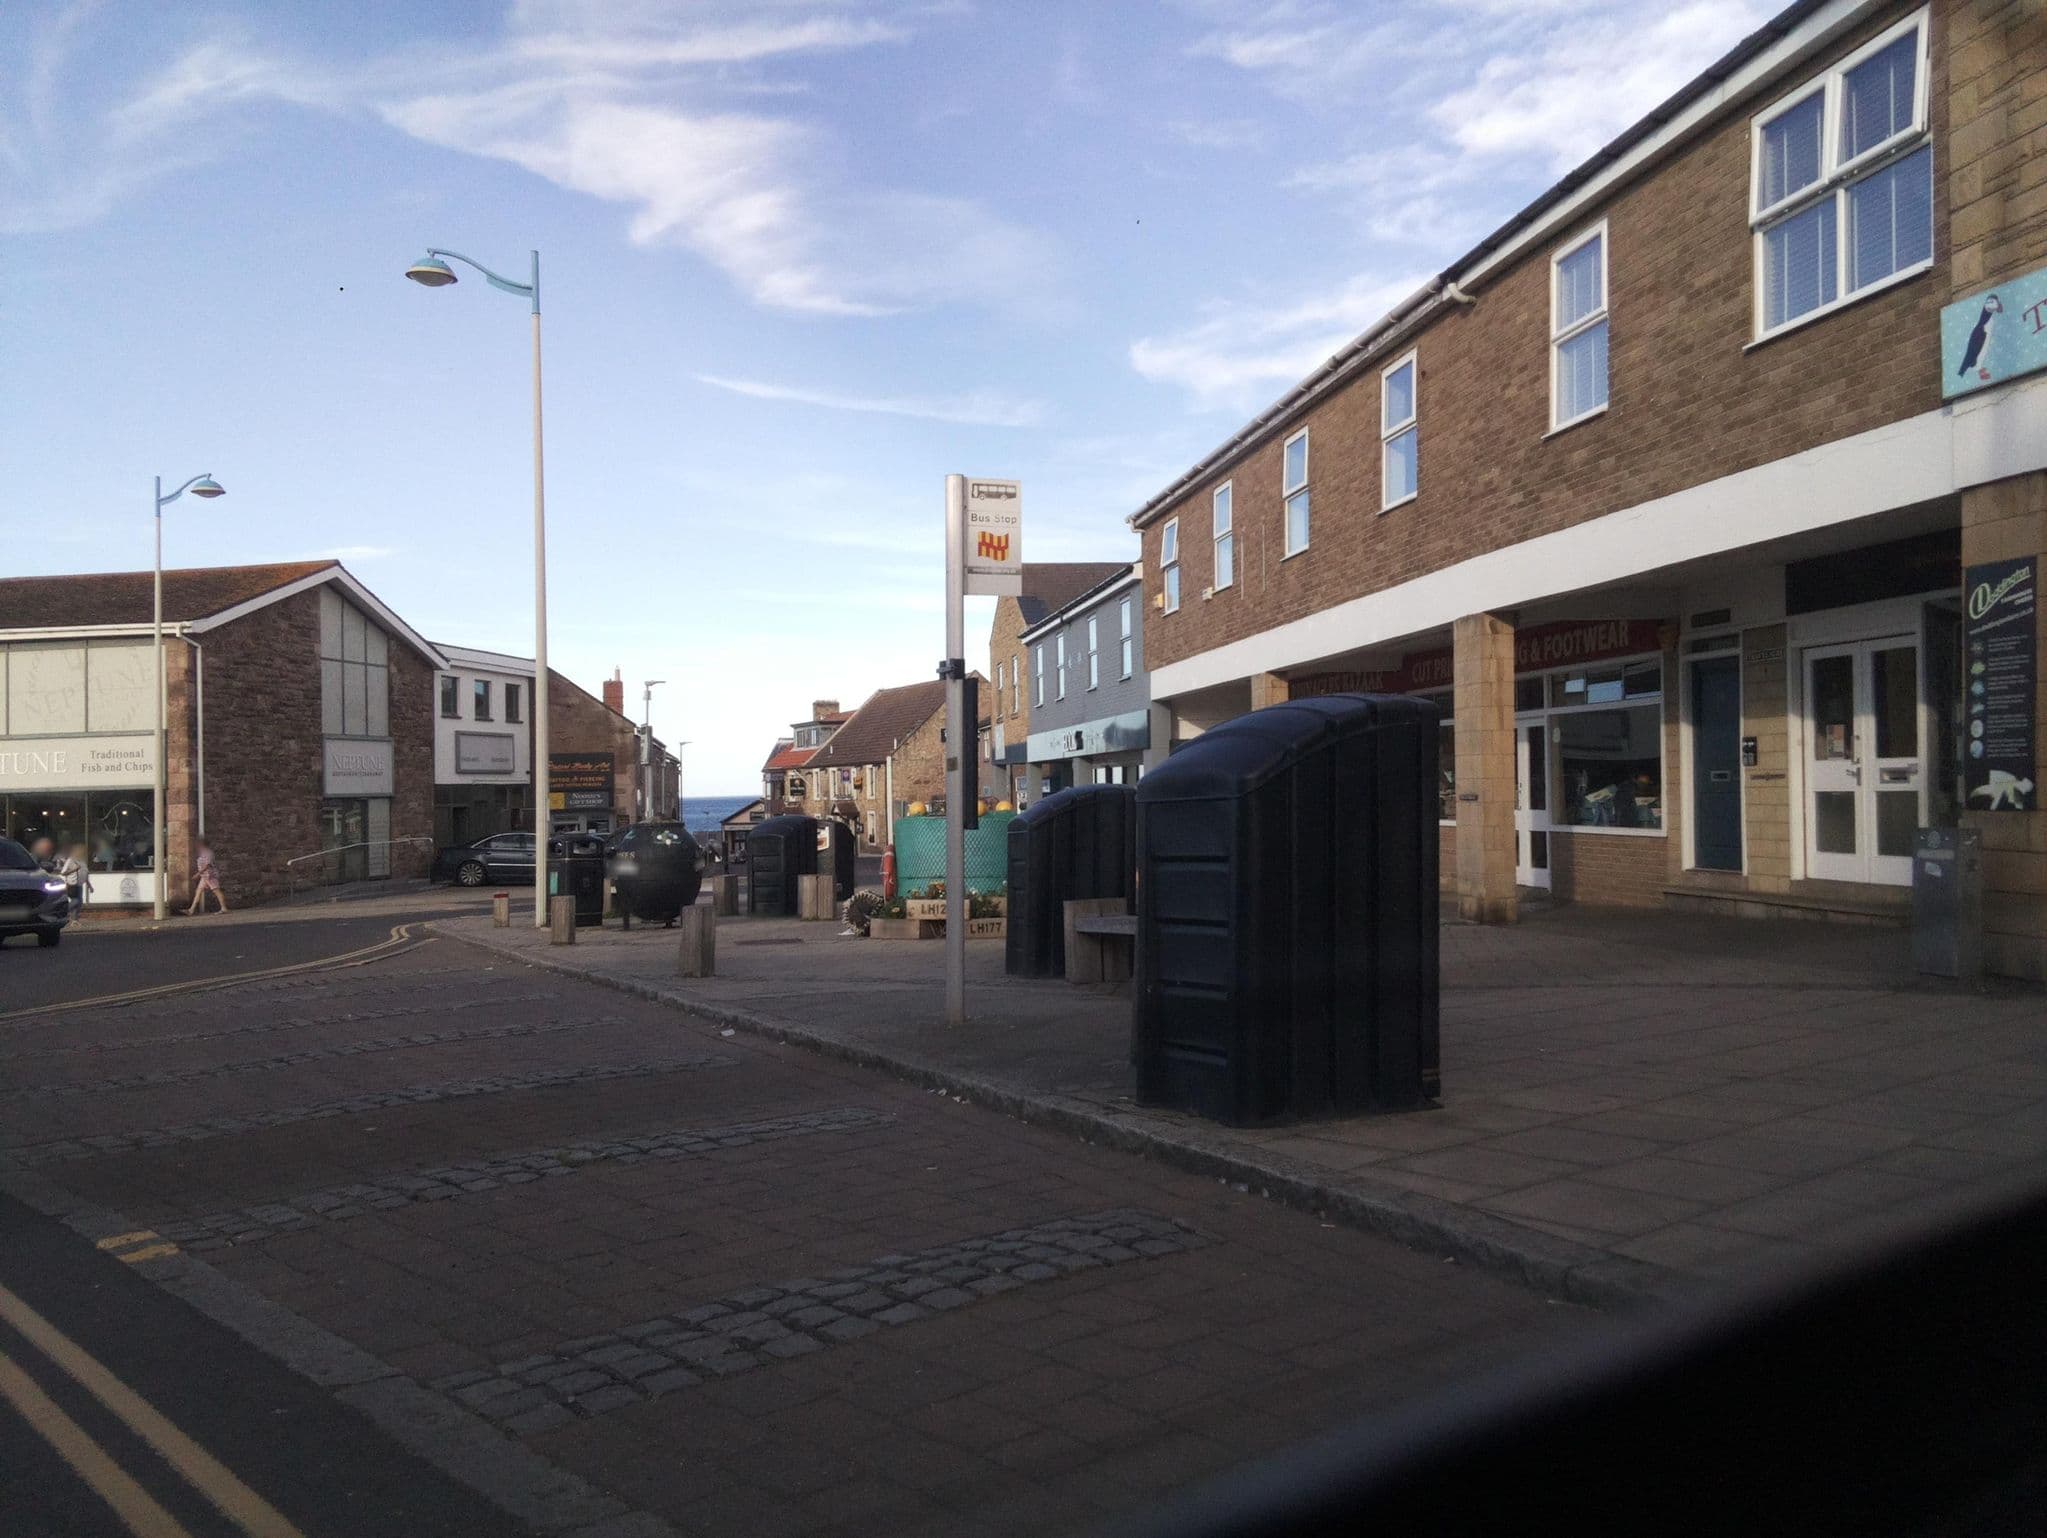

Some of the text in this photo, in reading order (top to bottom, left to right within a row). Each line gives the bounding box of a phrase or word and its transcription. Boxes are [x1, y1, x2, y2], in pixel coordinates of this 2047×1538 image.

[970, 512, 1017, 524] Bus Stop
[1412, 660, 1432, 683] CUT
[1531, 636, 1541, 662] &
[1544, 619, 1629, 661] FOOTWEAR
[90, 749, 144, 759] Traditional
[332, 751, 385, 770] NEPTUNE
[81, 761, 153, 774] Fish and Chips
[970, 922, 1002, 934] LH177
